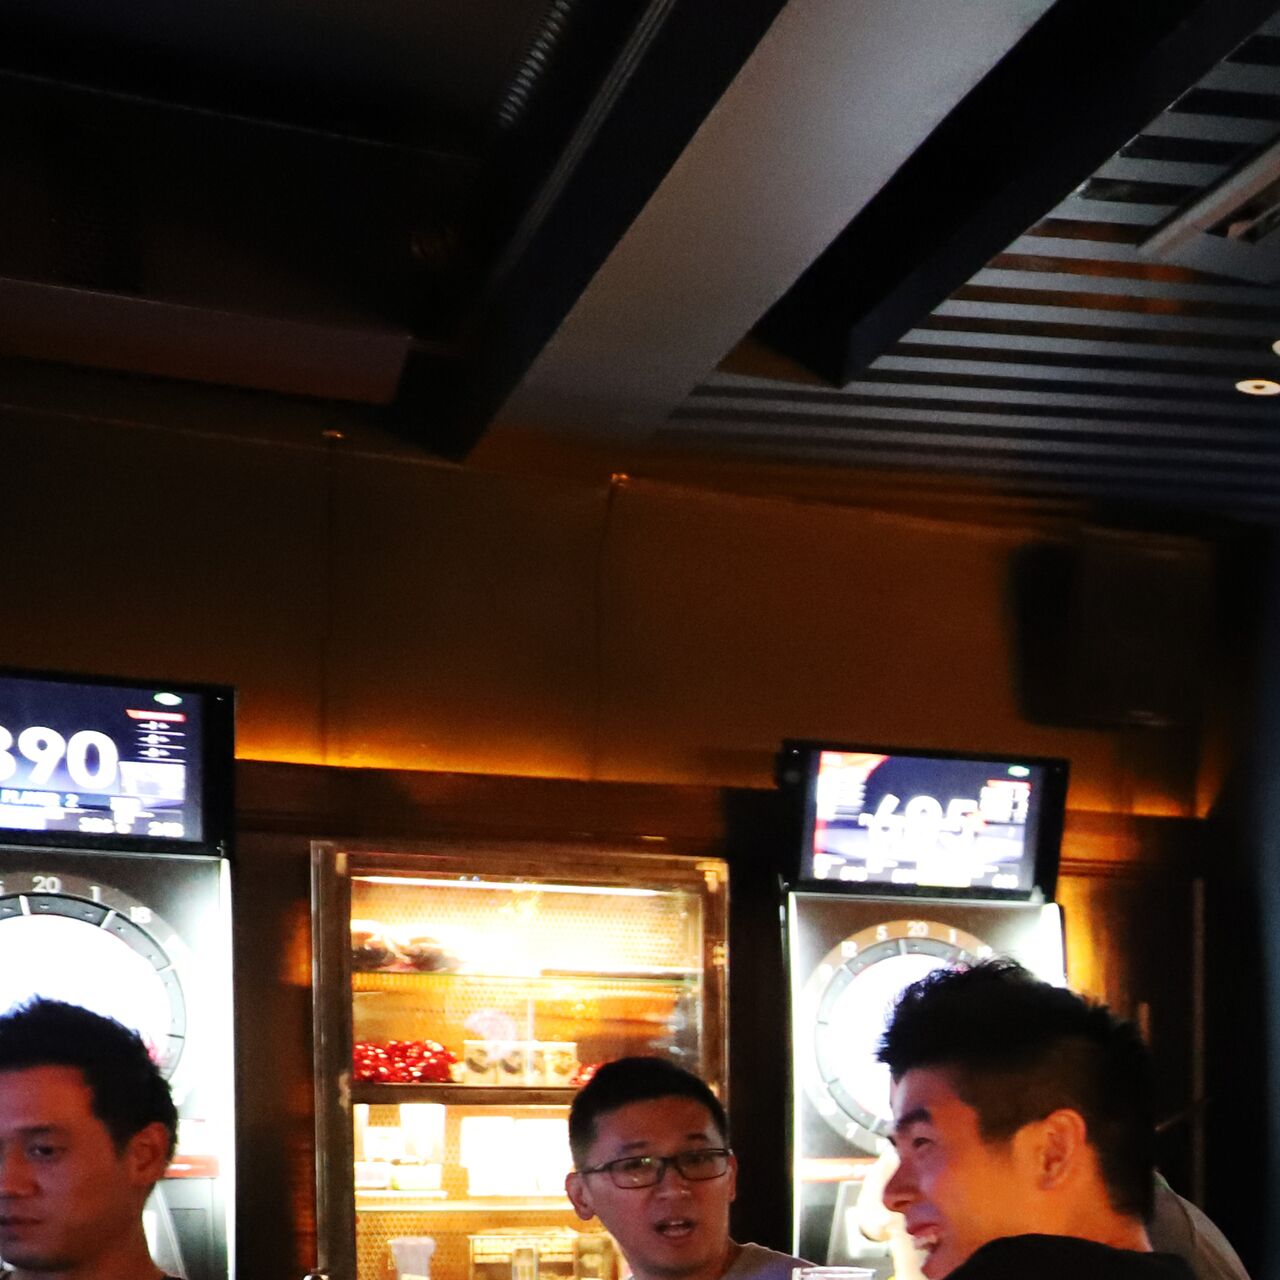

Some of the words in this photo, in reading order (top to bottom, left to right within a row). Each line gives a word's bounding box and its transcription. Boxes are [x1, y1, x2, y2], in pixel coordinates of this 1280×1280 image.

[32, 876, 61, 893] 20
[90, 886, 101, 901] 1
[907, 921, 929, 937] 20
